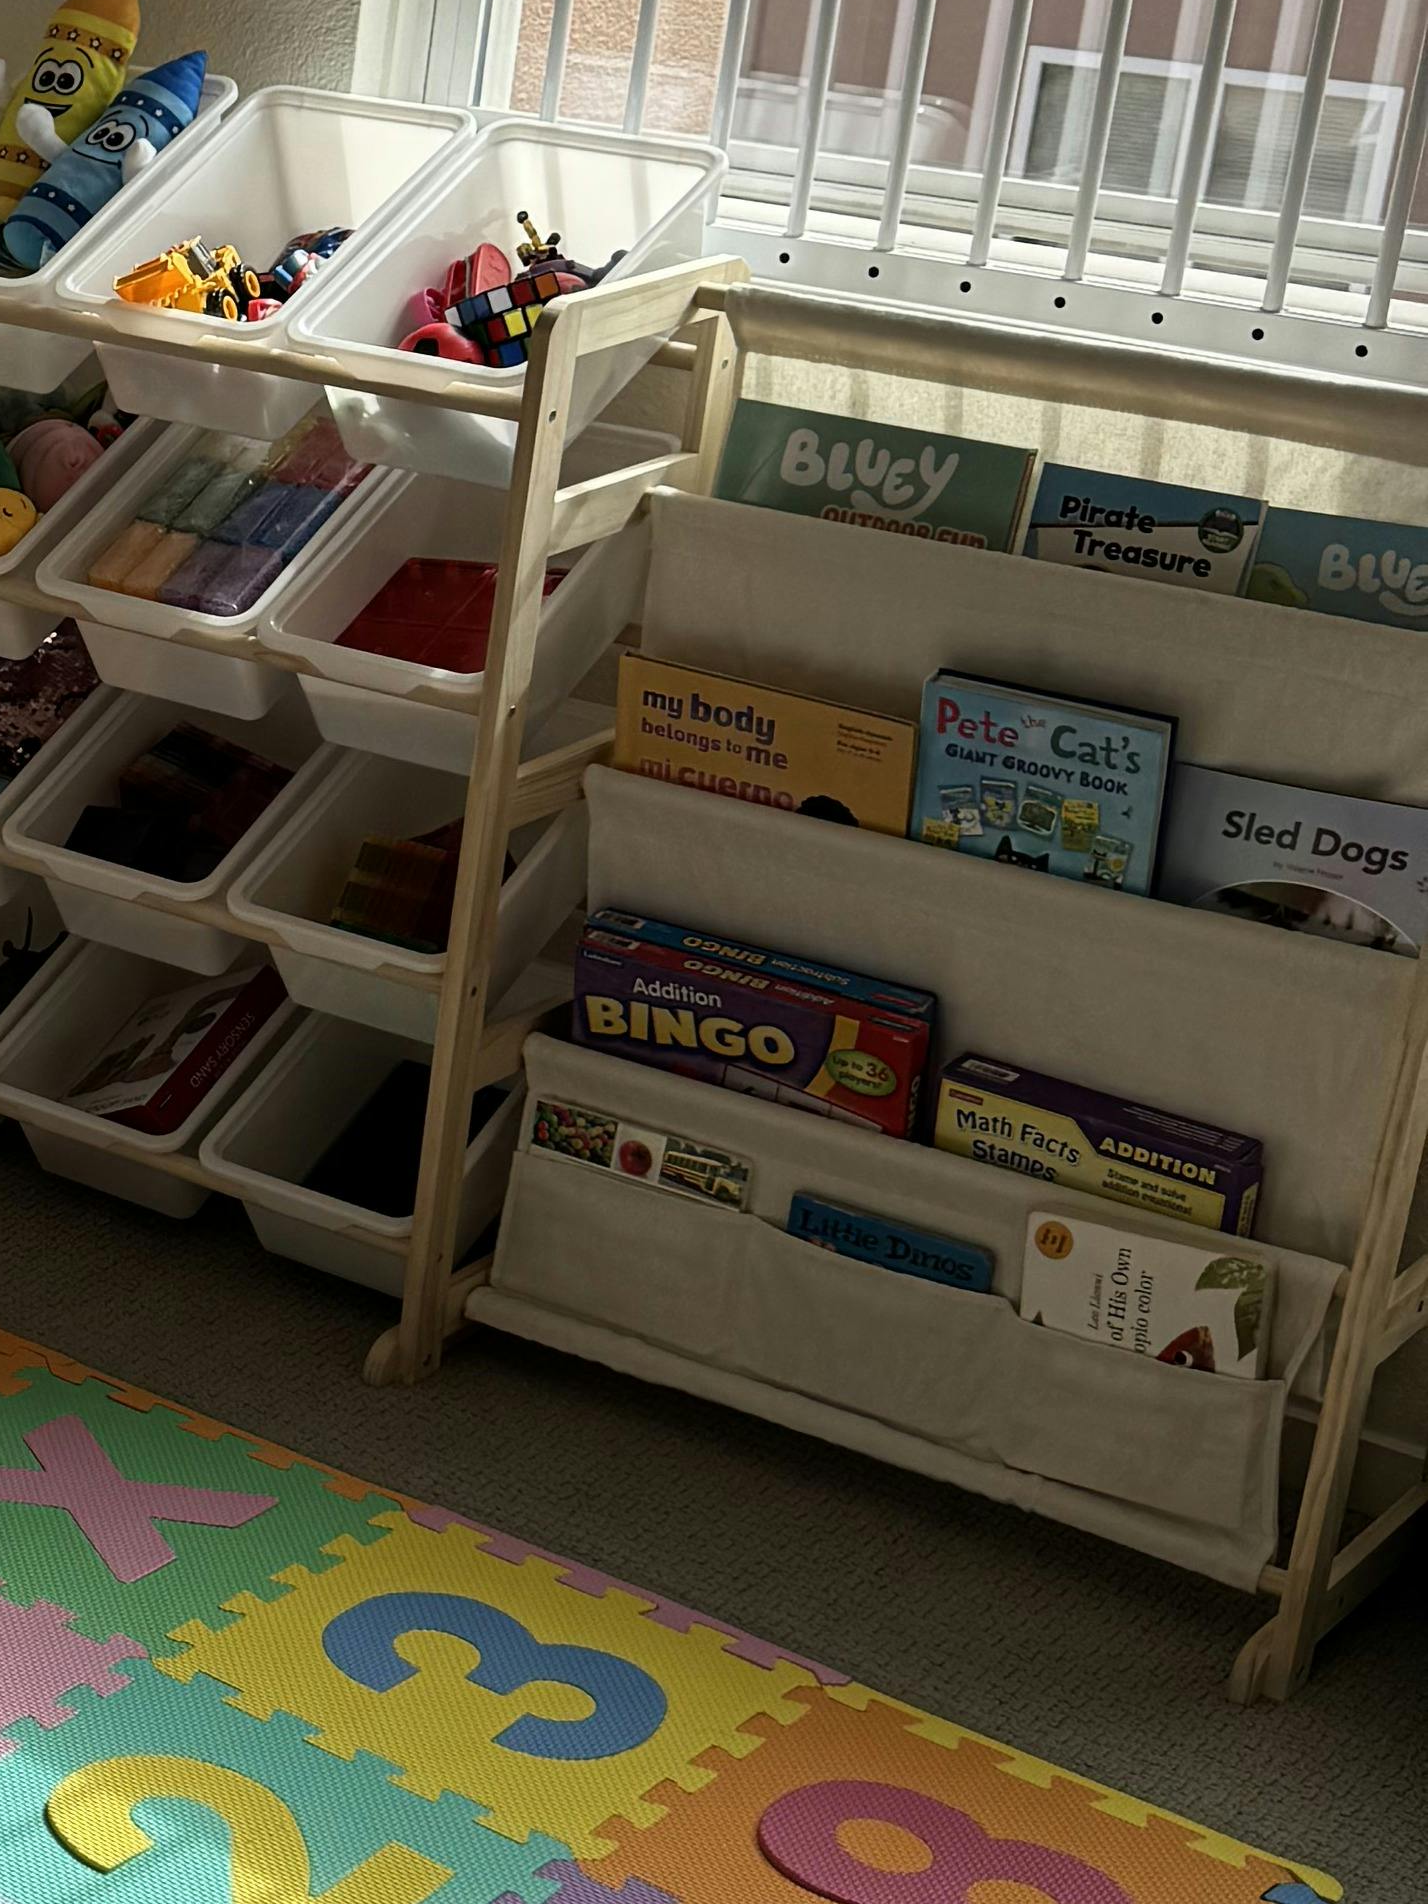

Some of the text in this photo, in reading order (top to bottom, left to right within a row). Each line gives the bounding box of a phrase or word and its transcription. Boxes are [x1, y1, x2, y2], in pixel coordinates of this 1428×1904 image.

[780, 428, 959, 521] BLUEY
[1059, 495, 1156, 533] Pirate
[1074, 529, 1211, 577] Treasure
[643, 688, 775, 745] my body
[937, 698, 1019, 747] Pete
[1020, 714, 1047, 729] the
[1050, 725, 1141, 774] Cat's
[640, 758, 671, 780] mi
[641, 717, 789, 770] belongs to me
[945, 743, 1129, 796] GIANT GROOVY BOOK
[1222, 809, 1301, 851] Sled
[1312, 827, 1408, 874] Dogs
[682, 936, 850, 985] Subtraction BINGO
[683, 959, 835, 1006] Addition BINGO
[632, 977, 722, 1009] Addition
[189, 1011, 256, 1088] SENSORY SAND
[583, 994, 796, 1067] BINGO
[833, 1055, 889, 1081] Up to 36
[839, 1070, 883, 1090] players!
[956, 1108, 1080, 1164] Math Facts
[972, 1140, 1057, 1184] Stamps
[1098, 1136, 1217, 1186] ADDITION
[798, 1207, 975, 1283] Little Dinos
[1107, 1247, 1132, 1341] of His Own
[1139, 1270, 1155, 1305] color
[321, 1591, 669, 1761] 3
